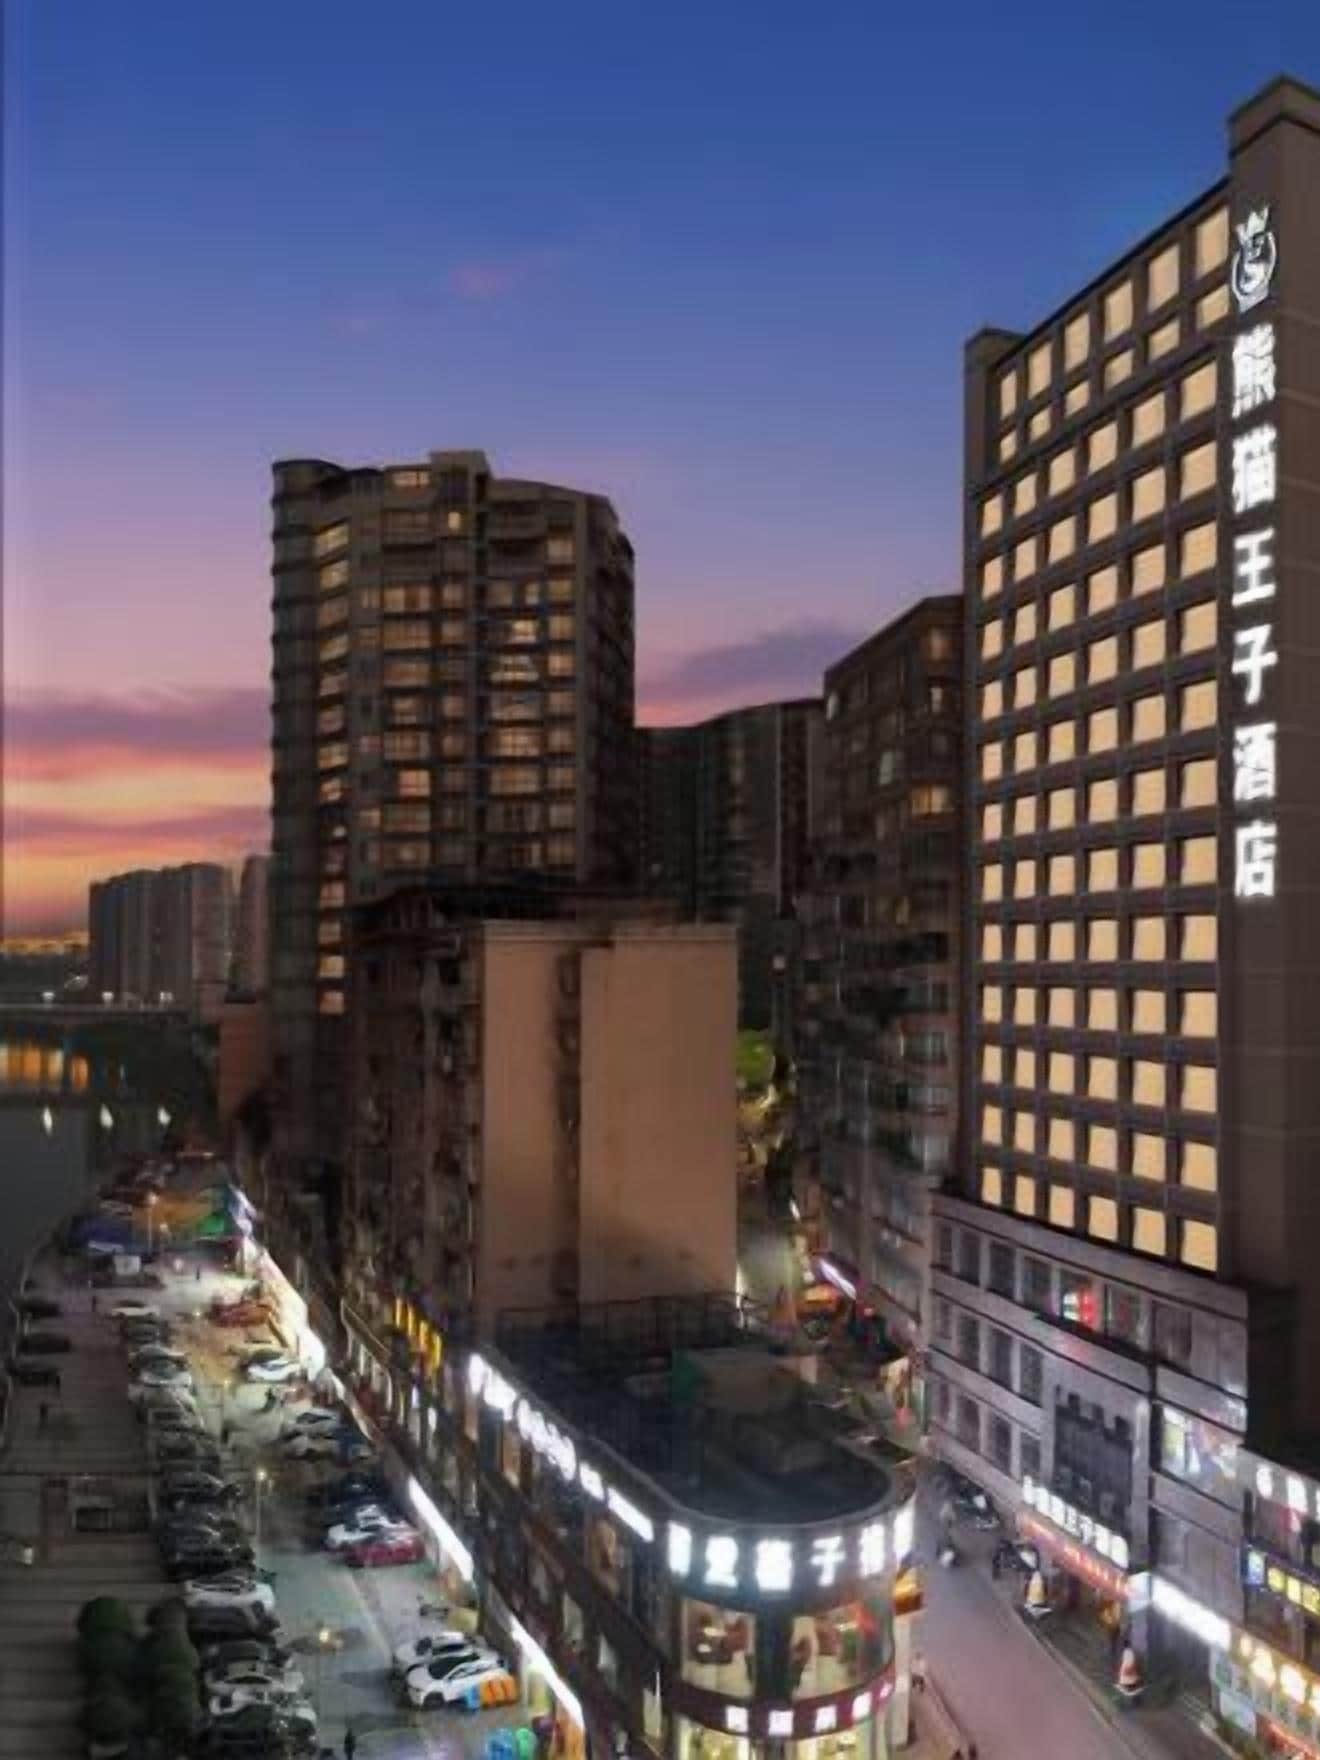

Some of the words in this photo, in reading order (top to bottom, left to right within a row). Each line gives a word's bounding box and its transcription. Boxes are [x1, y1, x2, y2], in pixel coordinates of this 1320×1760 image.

[1231, 322, 1278, 898] 熊猫王子酒店
